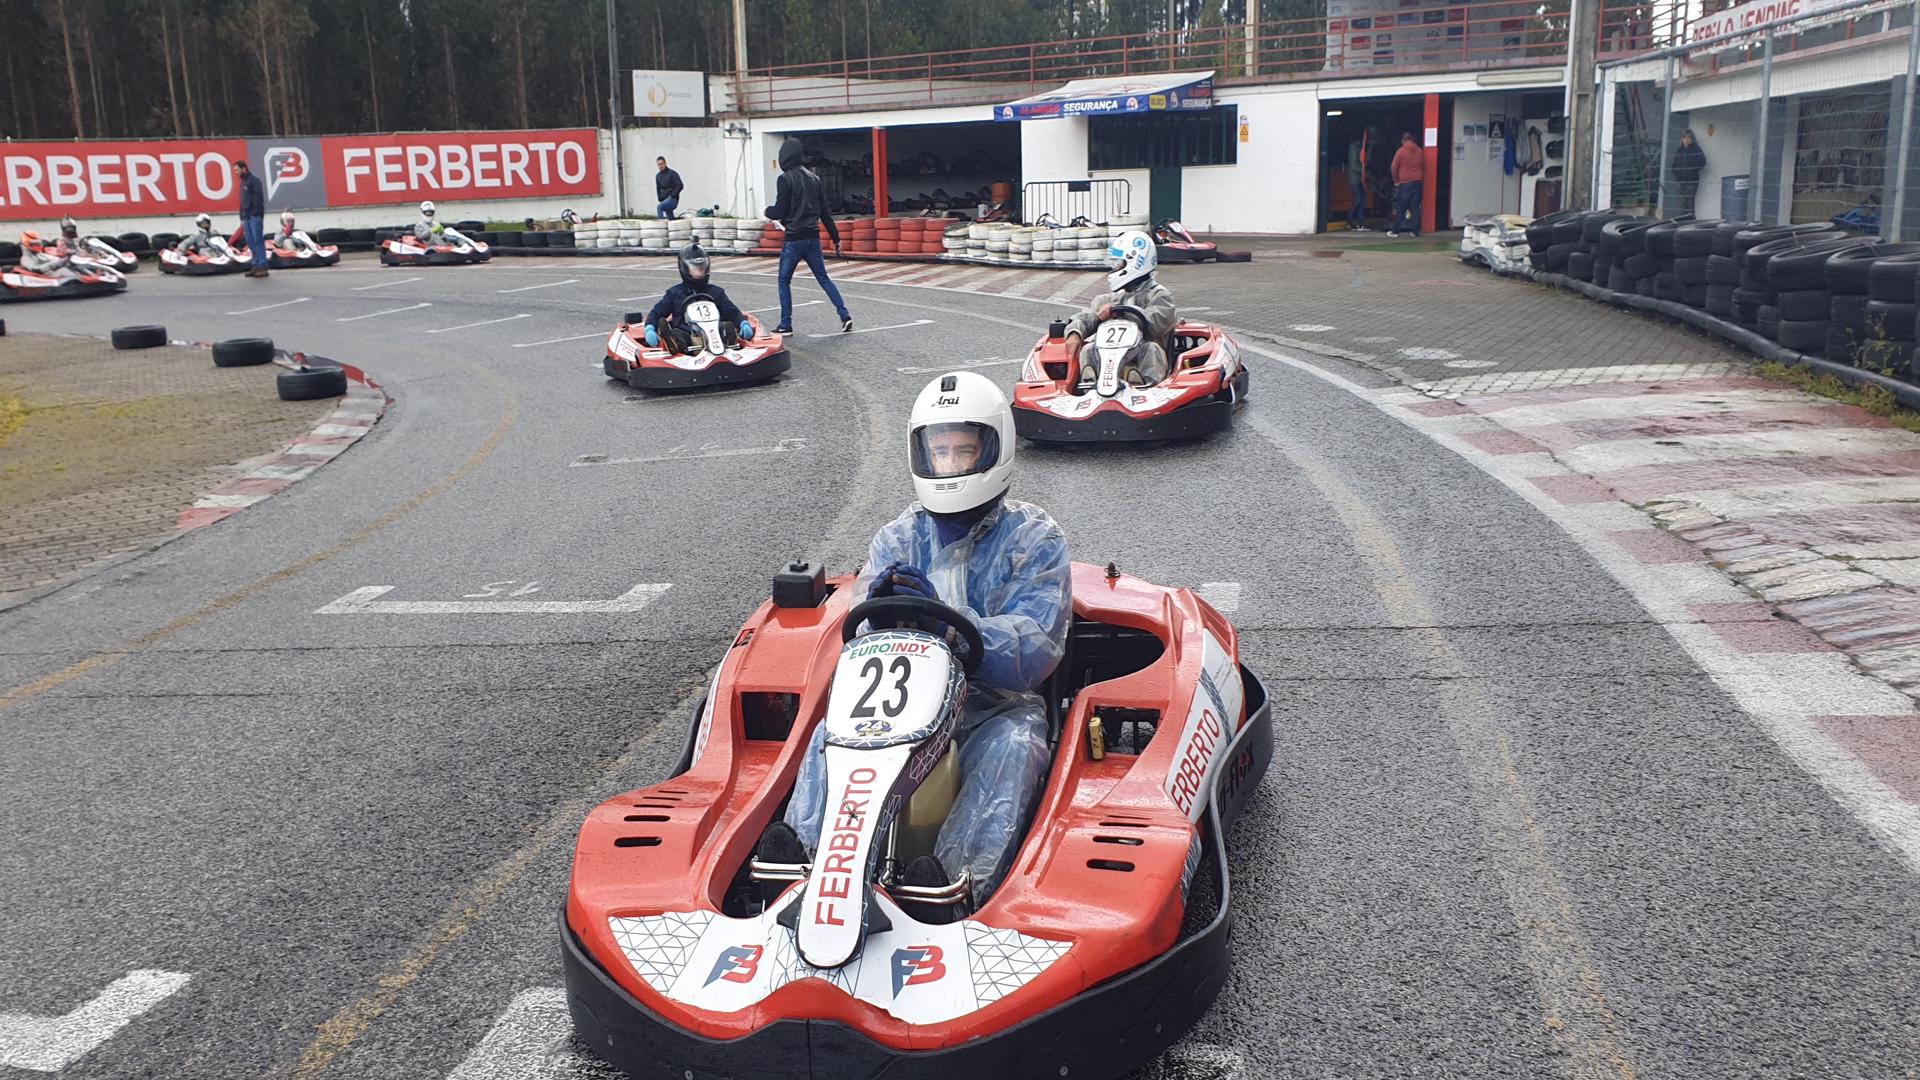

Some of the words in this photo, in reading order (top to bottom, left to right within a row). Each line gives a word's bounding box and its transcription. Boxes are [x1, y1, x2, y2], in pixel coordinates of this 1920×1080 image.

[1063, 100, 1118, 112] SEGURANÇA
[0, 151, 233, 206] RBERTO
[343, 141, 586, 193] FERBERTO
[696, 305, 711, 317] 13
[1105, 327, 1127, 343] 27
[931, 395, 960, 407] Arai
[848, 643, 931, 660] EUROINDY
[850, 655, 912, 719] 23
[815, 767, 877, 927] FERBERTO
[702, 943, 764, 989] FB
[891, 944, 947, 1001] FB
